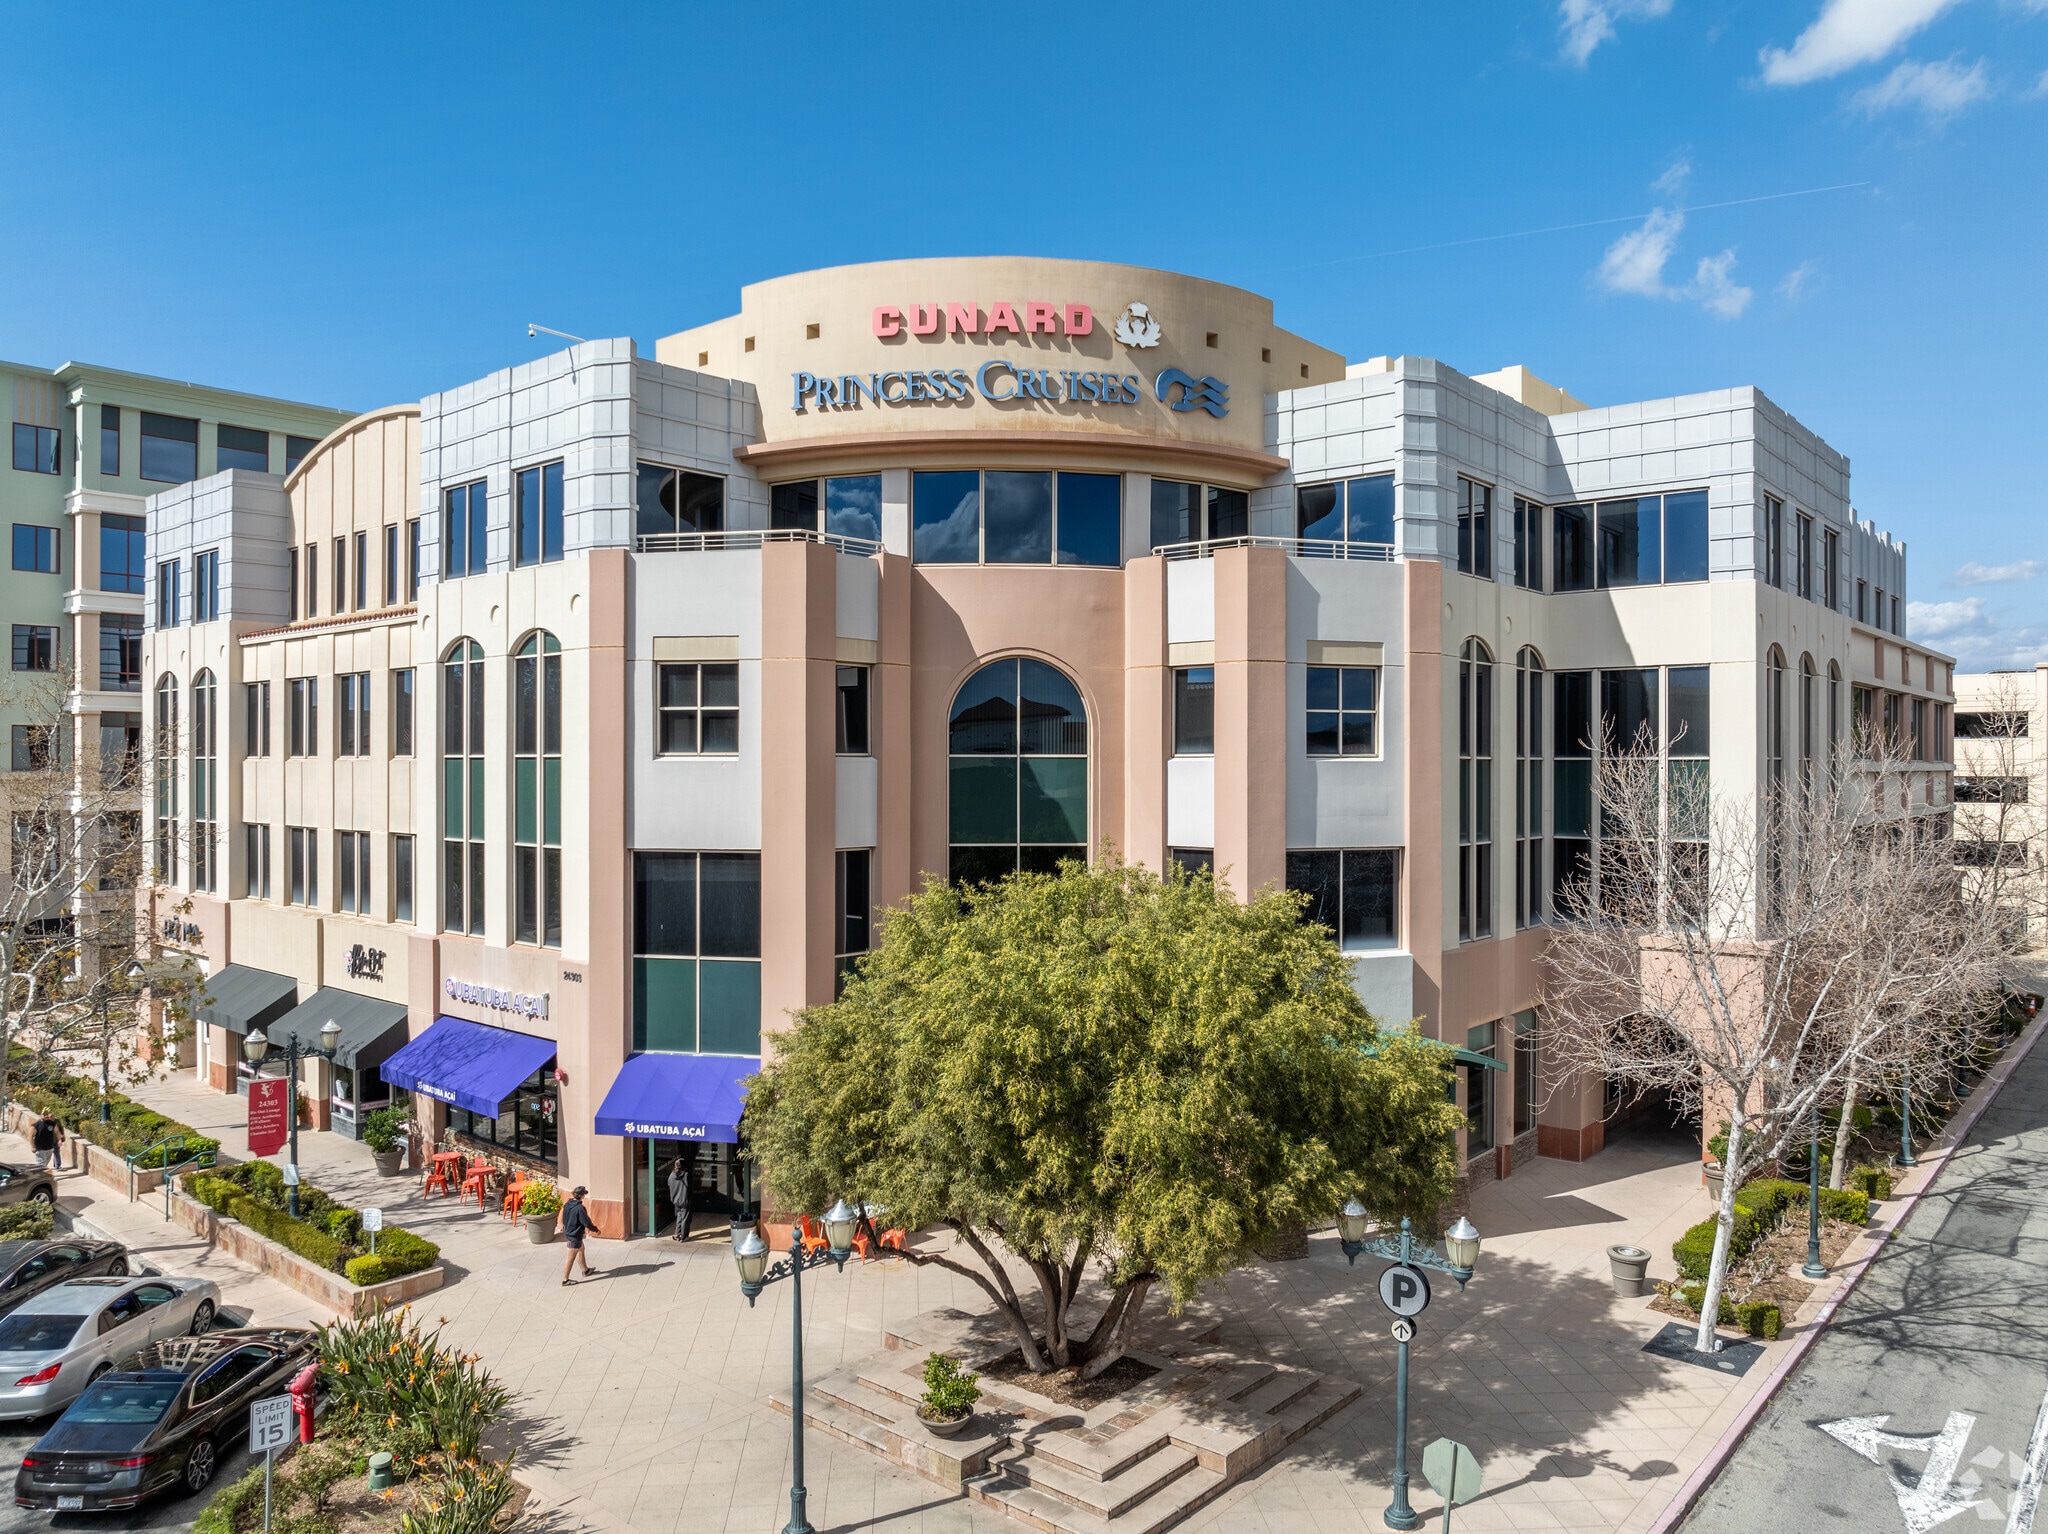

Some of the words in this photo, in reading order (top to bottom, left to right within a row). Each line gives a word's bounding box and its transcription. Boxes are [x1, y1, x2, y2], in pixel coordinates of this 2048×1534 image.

[872, 301, 1093, 337] CUNARD
[791, 368, 967, 411] PRINCESS
[976, 359, 1141, 405] CRUISES
[455, 981, 511, 1010] UBATUBA
[512, 991, 548, 1018] AÇAÍ
[422, 1083, 444, 1097] UBATUBA
[258, 1099, 278, 1107] 24303
[636, 1124, 680, 1135] UBATUBA
[682, 1125, 706, 1138] AÇAÍ
[1392, 1273, 1417, 1308] P
[255, 1400, 290, 1415] SPEED
[258, 1411, 285, 1425] LIMIT
[258, 1422, 284, 1446] 15
